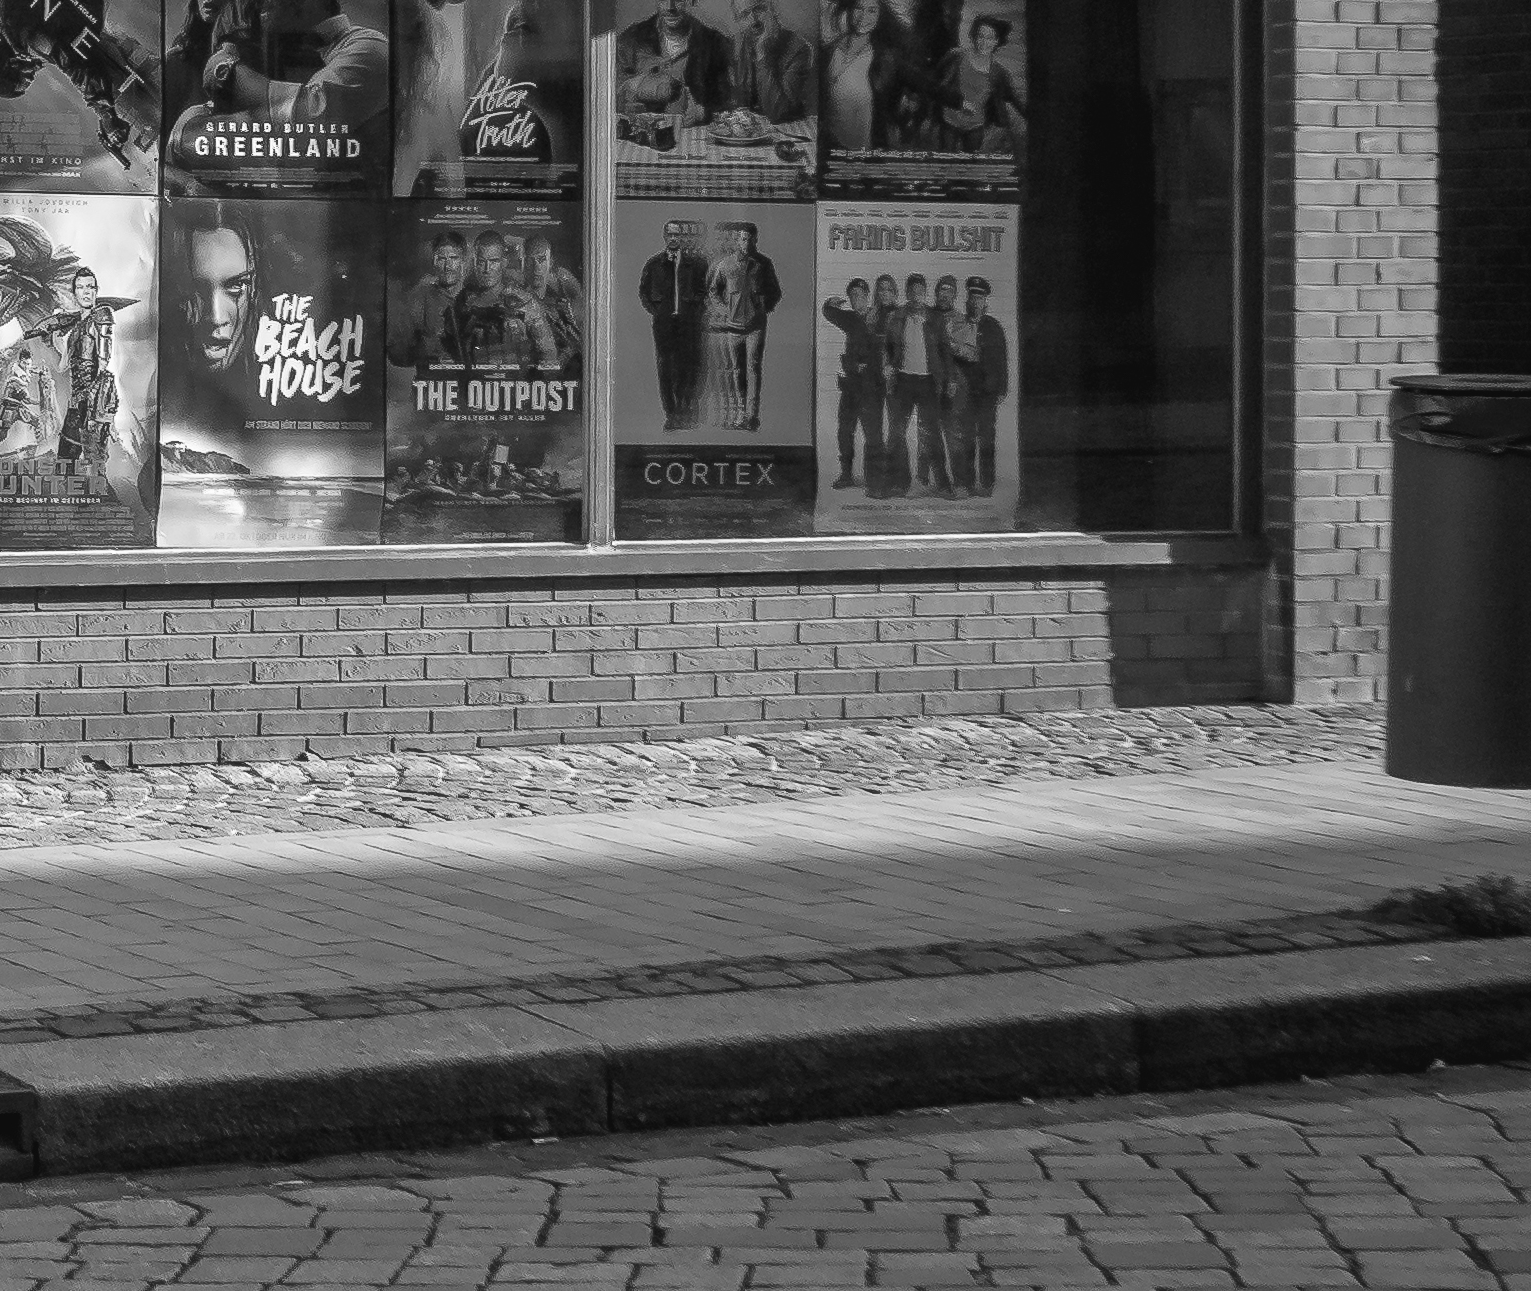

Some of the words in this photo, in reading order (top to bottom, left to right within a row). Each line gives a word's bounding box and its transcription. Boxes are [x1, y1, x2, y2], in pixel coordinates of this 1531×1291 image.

[205, 121, 272, 134] GERARD
[283, 122, 350, 135] BUTLER
[194, 136, 362, 159] GREENLAND
[909, 224, 1006, 253] BULLSHIT
[271, 292, 314, 322] THE
[254, 313, 364, 362] BEACH
[257, 358, 365, 406] HOUSE
[412, 379, 459, 412] THE
[467, 379, 579, 412] OUTPOST
[644, 461, 776, 486] CORTEX
